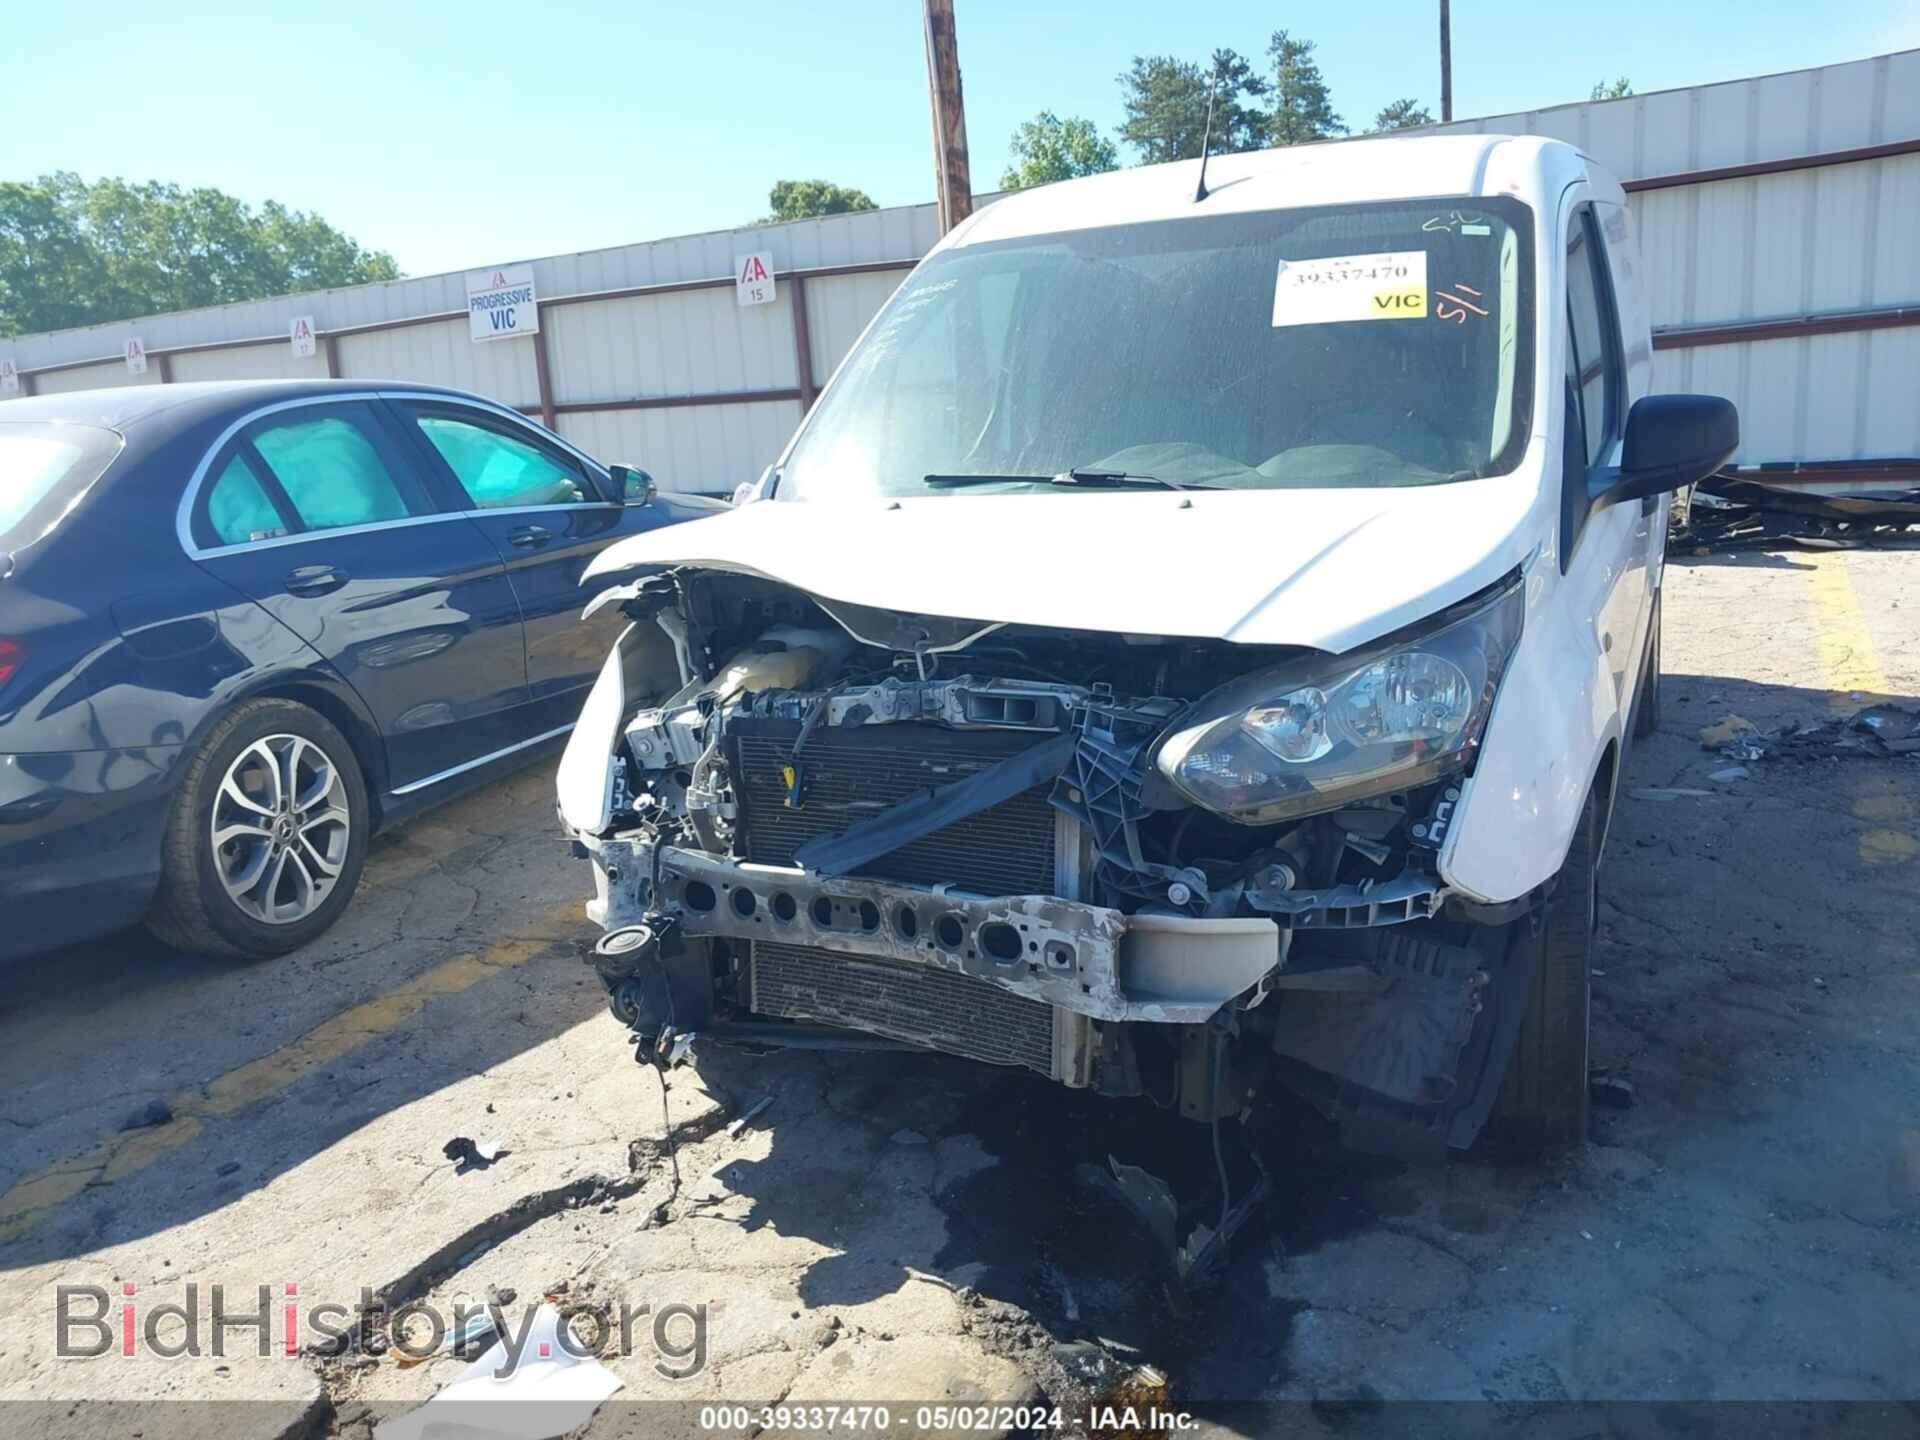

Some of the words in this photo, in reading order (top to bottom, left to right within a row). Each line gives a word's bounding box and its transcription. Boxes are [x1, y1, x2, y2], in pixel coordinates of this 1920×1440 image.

[1293, 264, 1408, 286] 39337470
[470, 287, 533, 312] PROGRESSIVE
[751, 288, 764, 302] 15
[1373, 292, 1422, 309] VIC
[490, 307, 516, 330] VIC
